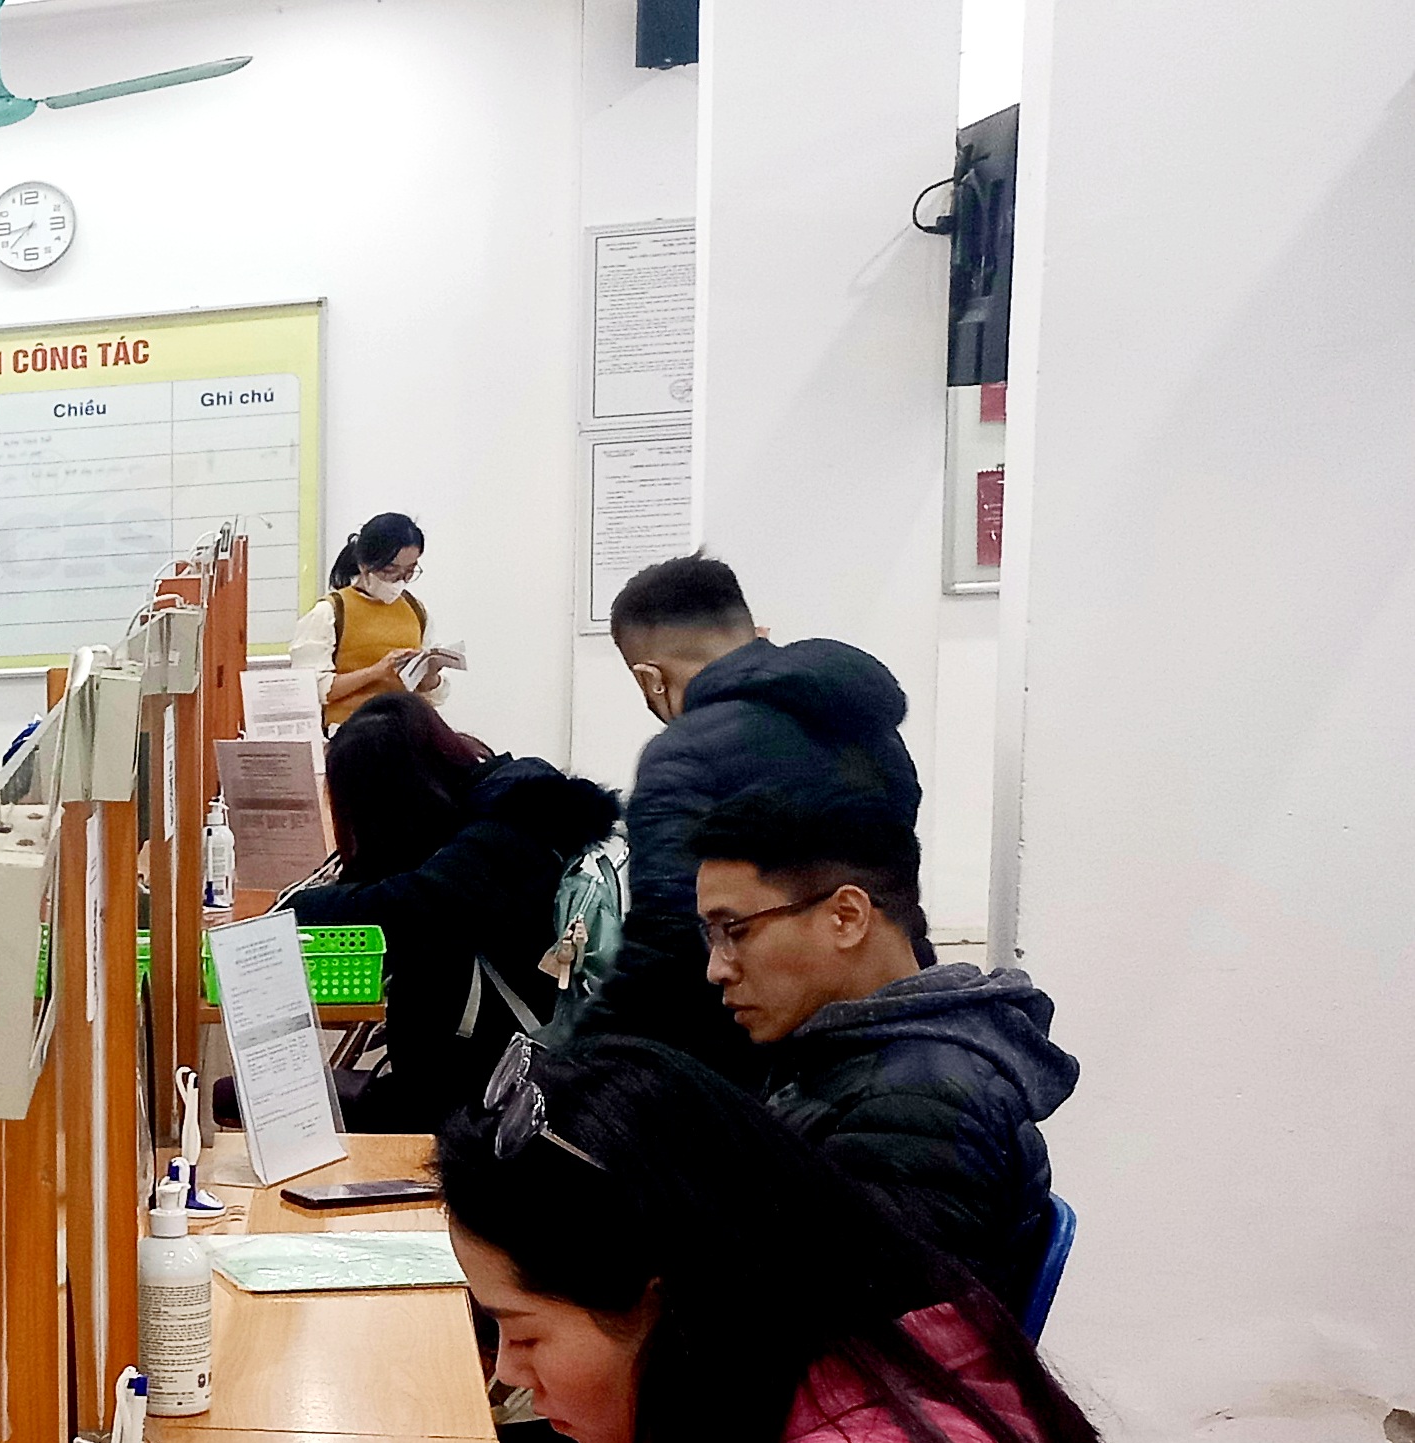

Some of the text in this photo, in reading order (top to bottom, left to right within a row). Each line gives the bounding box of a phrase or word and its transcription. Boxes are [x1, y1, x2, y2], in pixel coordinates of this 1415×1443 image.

[19, 190, 39, 206] 12
[49, 216, 65, 231] 3
[23, 247, 39, 261] 6
[12, 343, 88, 376] CÔNG
[97, 337, 151, 367] TÁC
[199, 386, 275, 408] Ghi chú
[52, 399, 108, 419] Chiều
